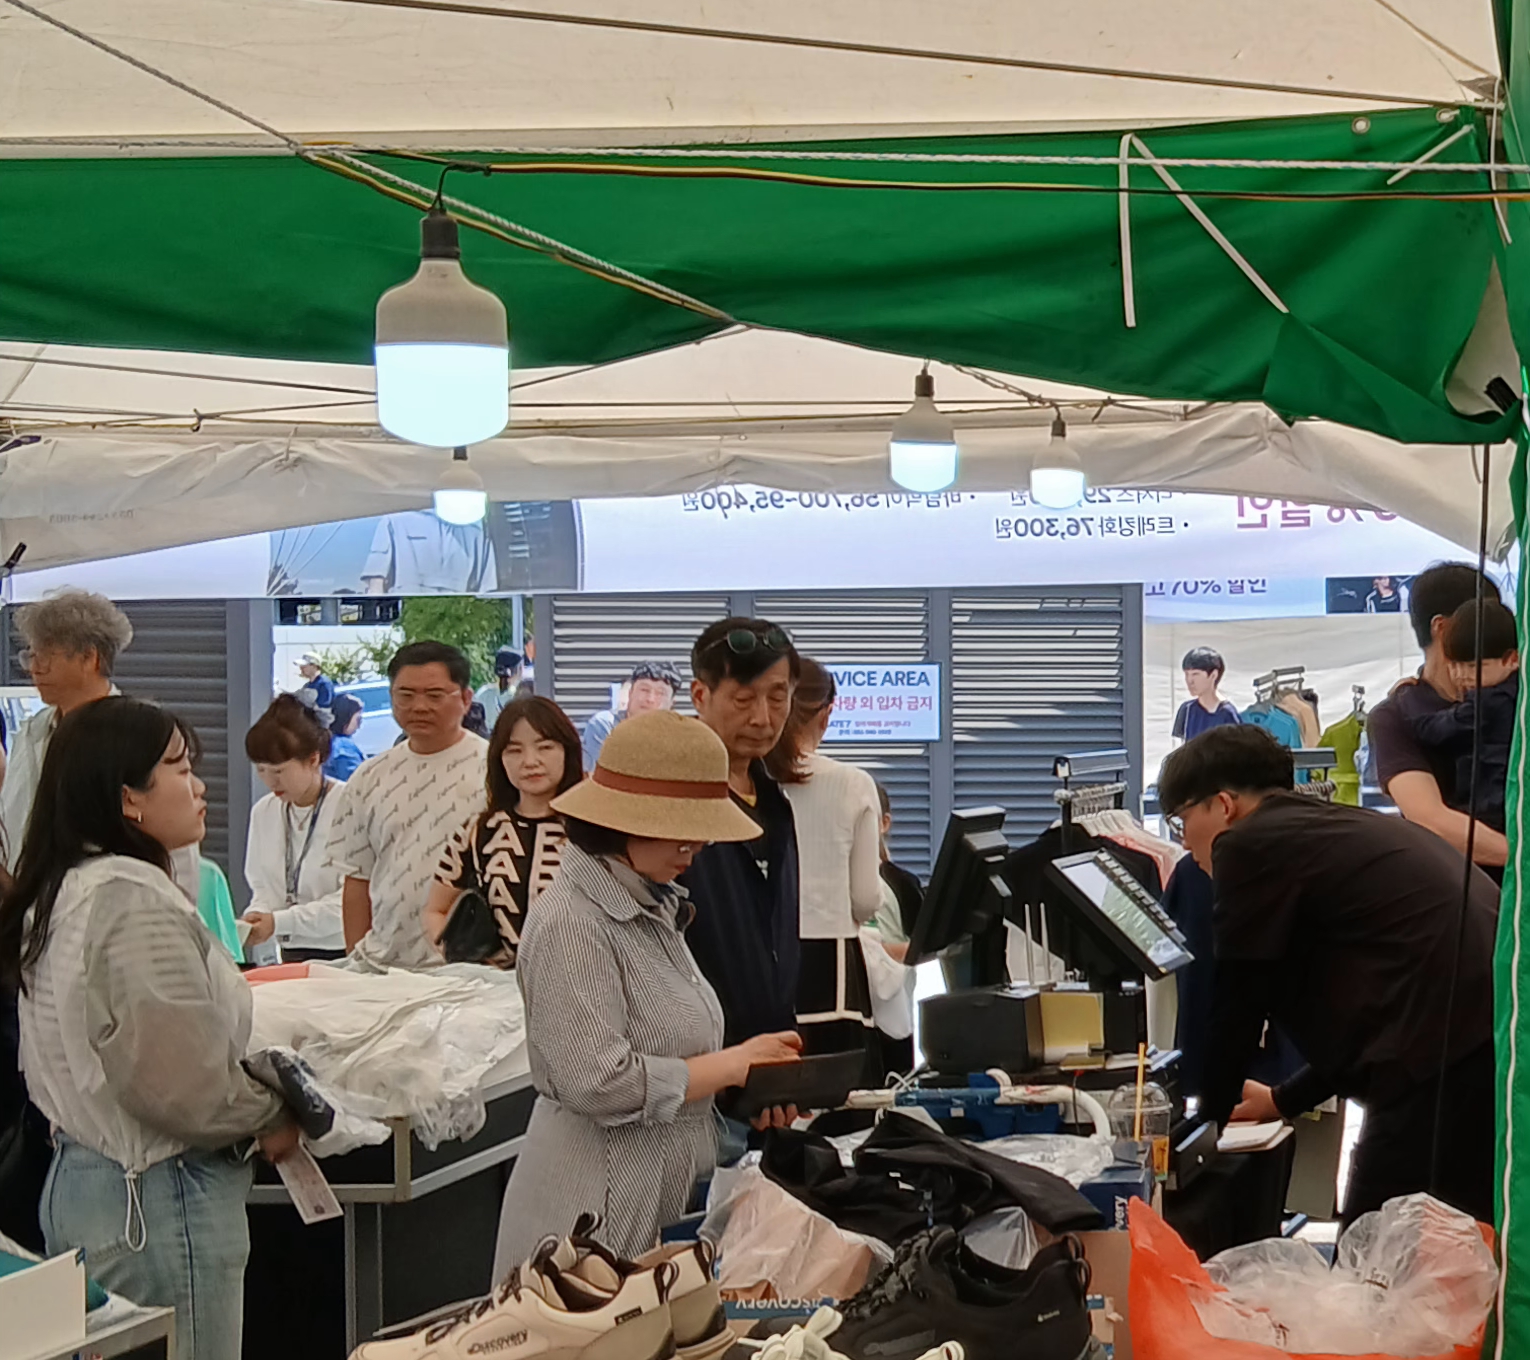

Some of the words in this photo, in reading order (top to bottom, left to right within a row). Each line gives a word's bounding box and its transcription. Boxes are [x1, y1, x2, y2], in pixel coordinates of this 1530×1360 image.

[832, 671, 877, 686] VICE
[880, 671, 931, 686] AREA
[907, 695, 933, 711] 금지
